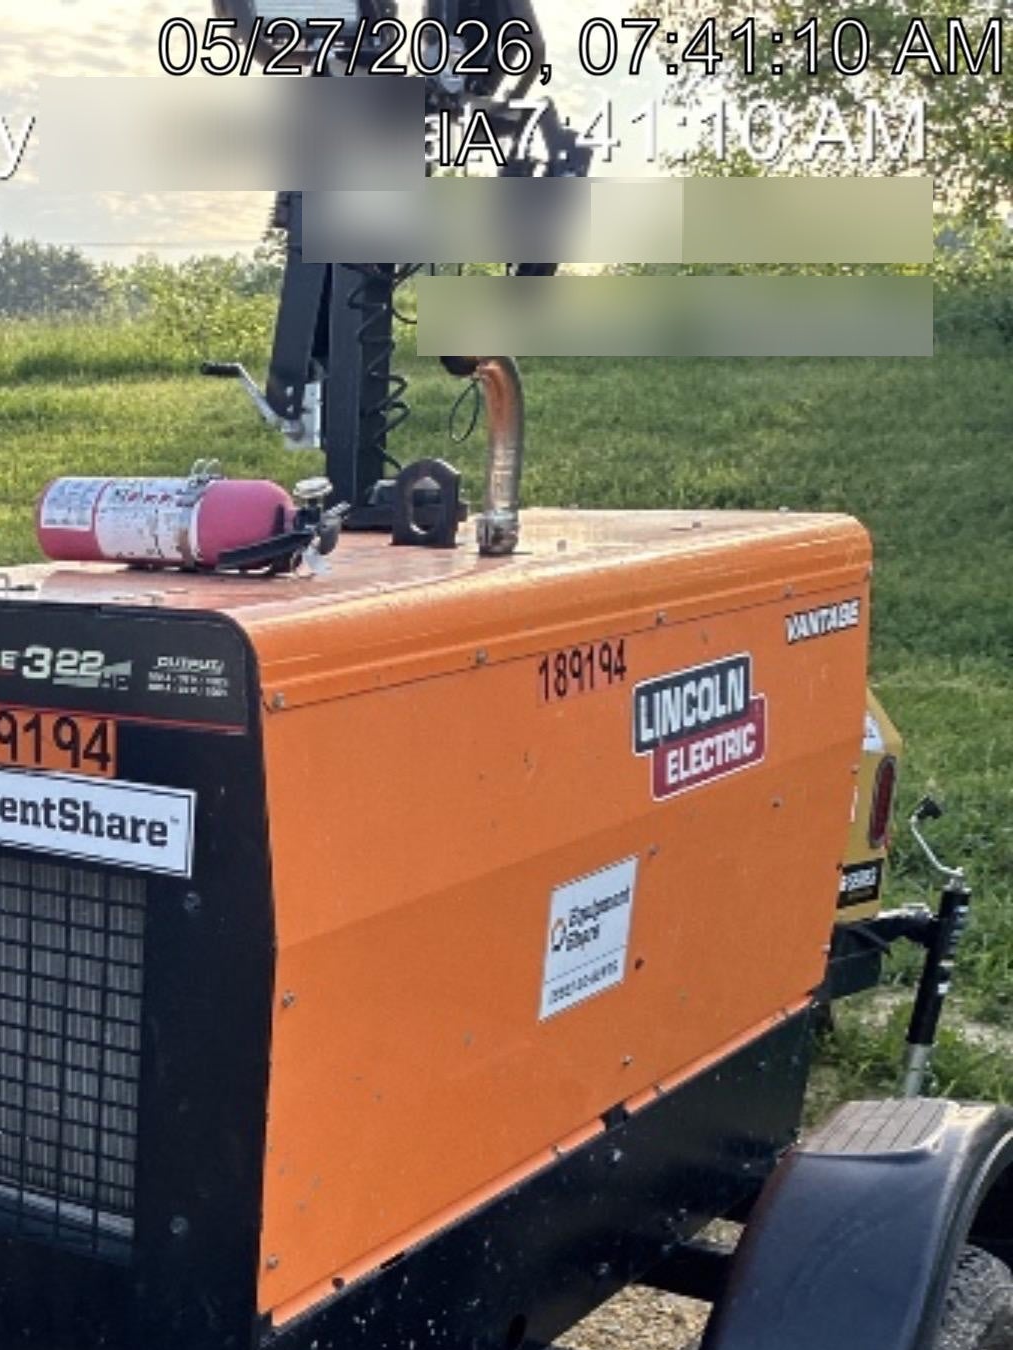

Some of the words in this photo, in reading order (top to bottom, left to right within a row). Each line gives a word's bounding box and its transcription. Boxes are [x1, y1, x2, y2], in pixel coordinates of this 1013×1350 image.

[785, 599, 860, 645] VANTAGE
[22, 644, 106, 680] 322
[538, 638, 628, 702] 189194
[639, 664, 746, 743] LINCOLN
[666, 722, 757, 786] ELECTRIC
